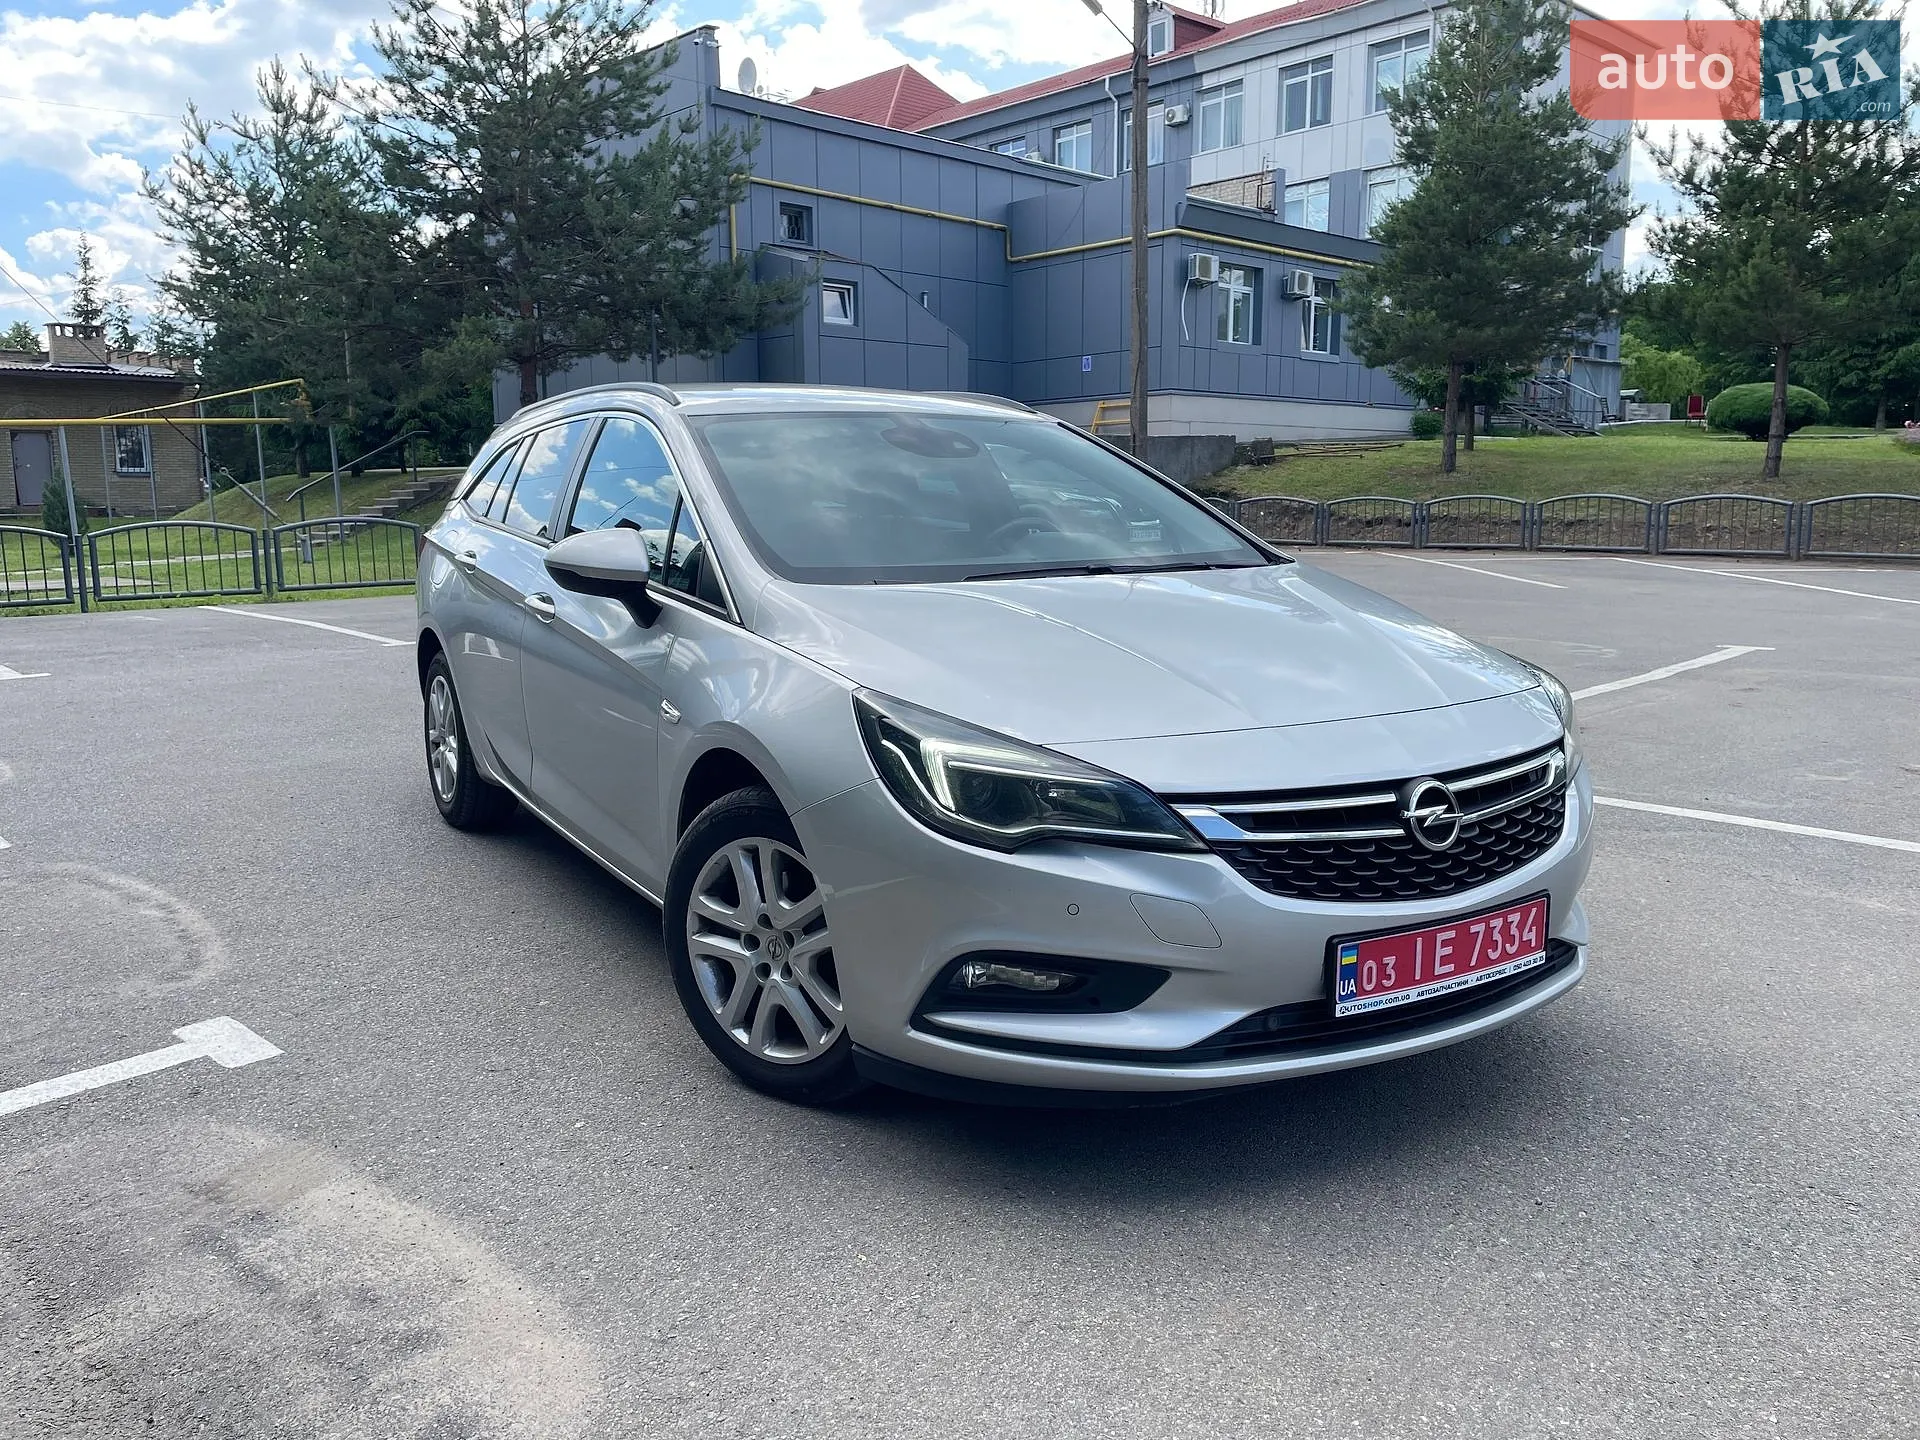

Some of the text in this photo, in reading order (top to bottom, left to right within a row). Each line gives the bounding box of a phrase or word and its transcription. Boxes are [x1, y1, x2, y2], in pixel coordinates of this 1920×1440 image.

[1362, 907, 1538, 992] 03 IE 7334
[1340, 976, 1357, 996] UA
[1416, 979, 1469, 998] АВТОЗАПЧАСТИНИ
